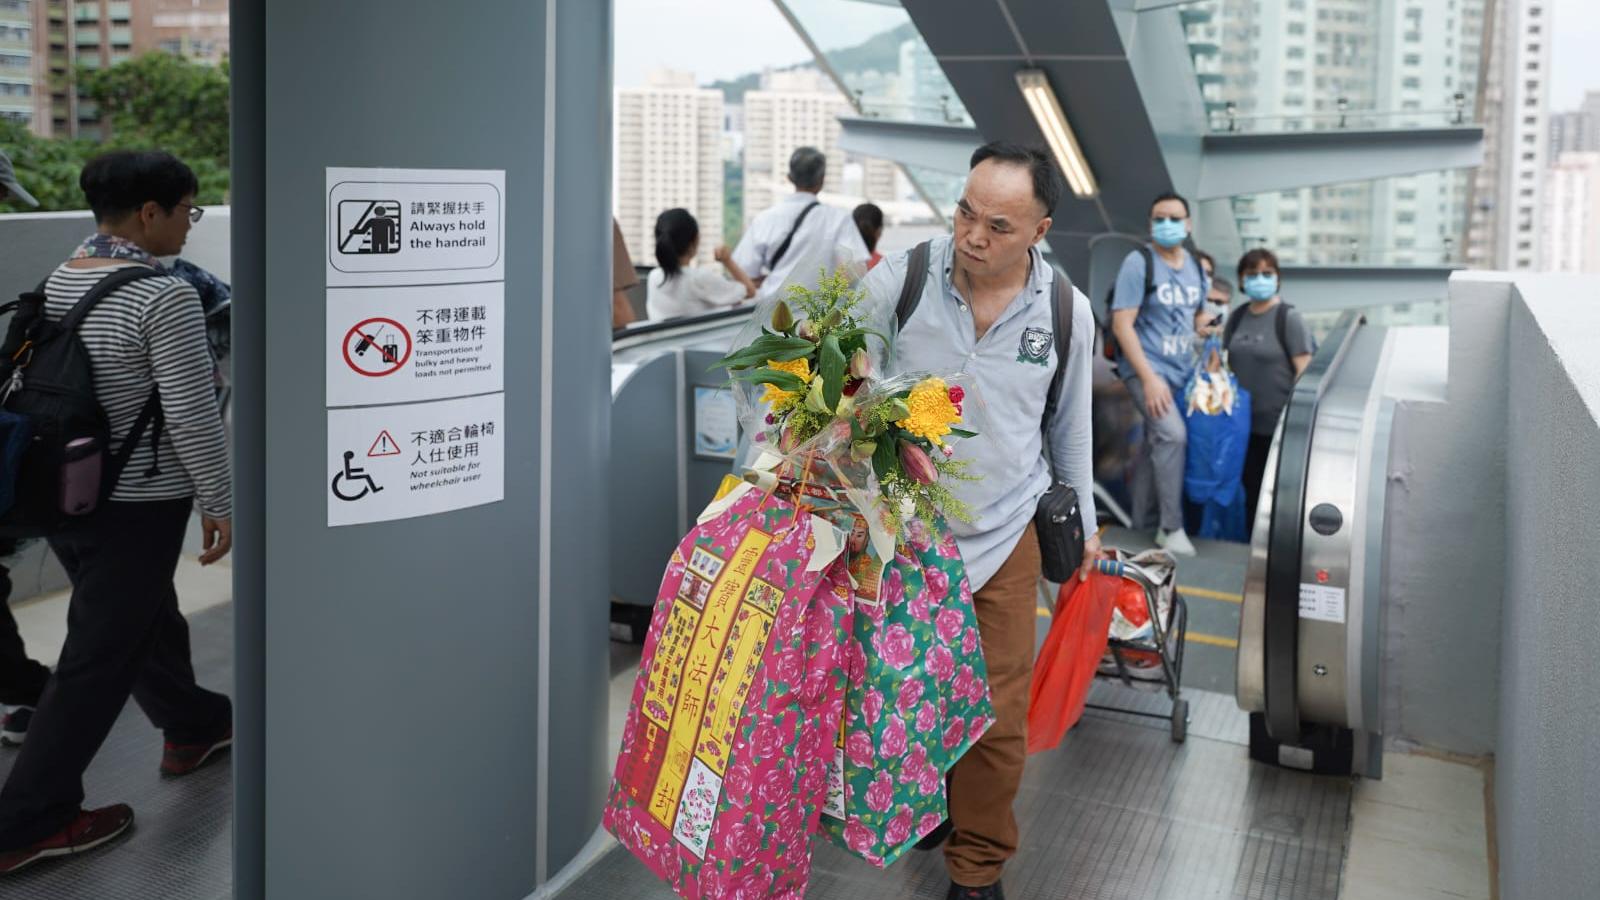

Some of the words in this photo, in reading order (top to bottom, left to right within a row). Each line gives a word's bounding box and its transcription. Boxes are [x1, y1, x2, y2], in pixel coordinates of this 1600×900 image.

[410, 201, 485, 215] 請緊握扶手
[410, 220, 455, 233] Always
[459, 219, 485, 231] hold
[410, 237, 432, 248] the
[435, 236, 485, 248] handrail
[1157, 283, 1200, 305] GAP
[416, 305, 486, 325] 不得運載
[416, 325, 486, 345] 笨重物件
[415, 346, 473, 357] Transportation
[456, 356, 478, 364] heavy
[415, 370, 437, 378] loads
[454, 363, 492, 376] permitted
[410, 421, 495, 447] 不適合輪椅
[411, 442, 479, 466] 人仕使用
[410, 470, 428, 479] Not
[430, 464, 466, 476] suitable
[467, 461, 480, 472] for
[410, 477, 461, 491] wheelchair
[462, 473, 481, 482] user
